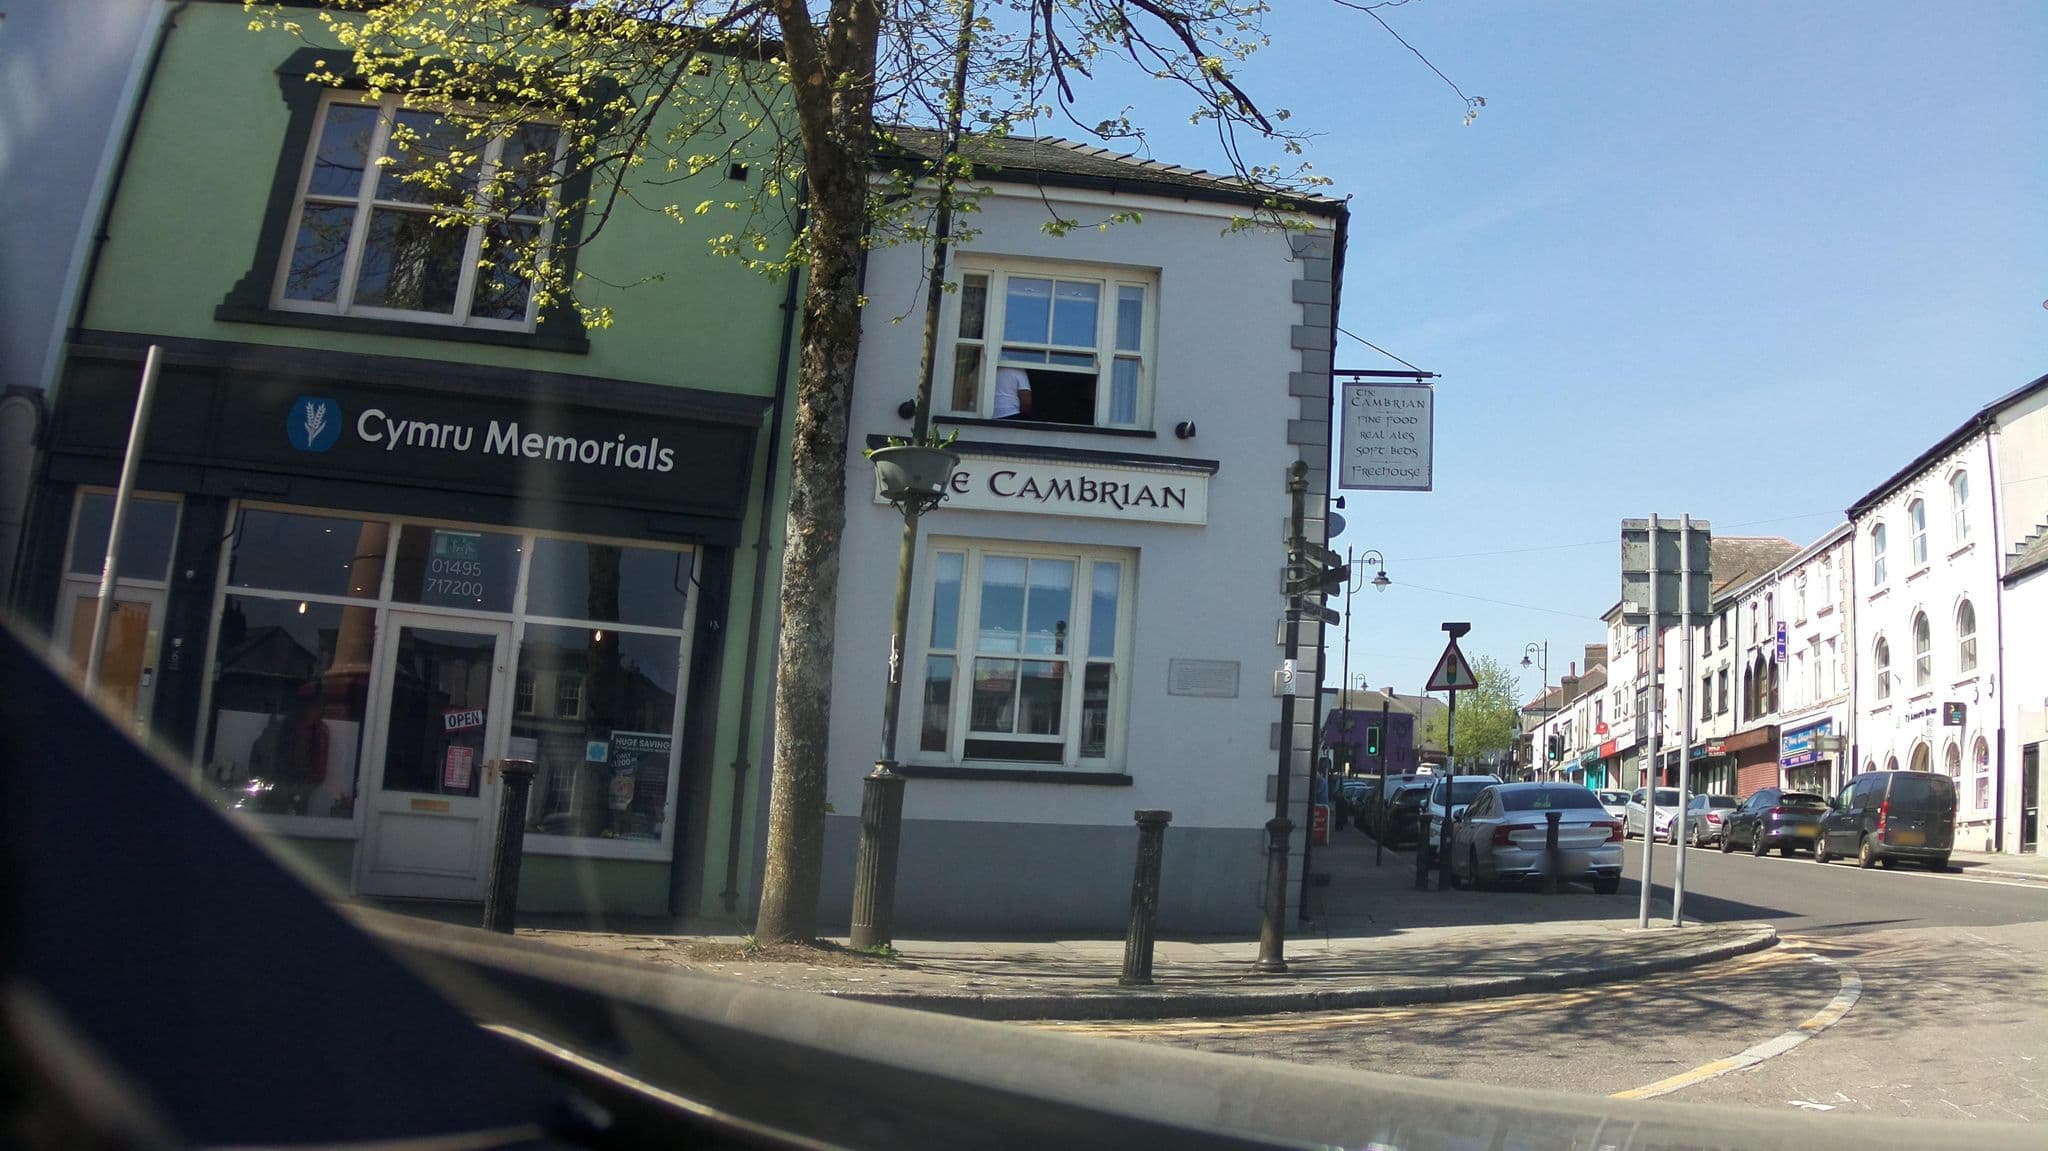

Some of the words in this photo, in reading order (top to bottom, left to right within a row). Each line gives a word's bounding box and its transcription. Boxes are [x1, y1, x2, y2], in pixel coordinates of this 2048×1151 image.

[1351, 397, 1425, 409] CAMBRIAN
[357, 408, 473, 451] Cymru
[483, 420, 674, 472] Memorials
[989, 470, 1186, 511] CAMBRIAN
[432, 559, 481, 576] 01495
[427, 578, 483, 596] 717200
[448, 711, 480, 728] OPEN
[615, 737, 638, 746] HUGE
[639, 739, 671, 749] SAVING
